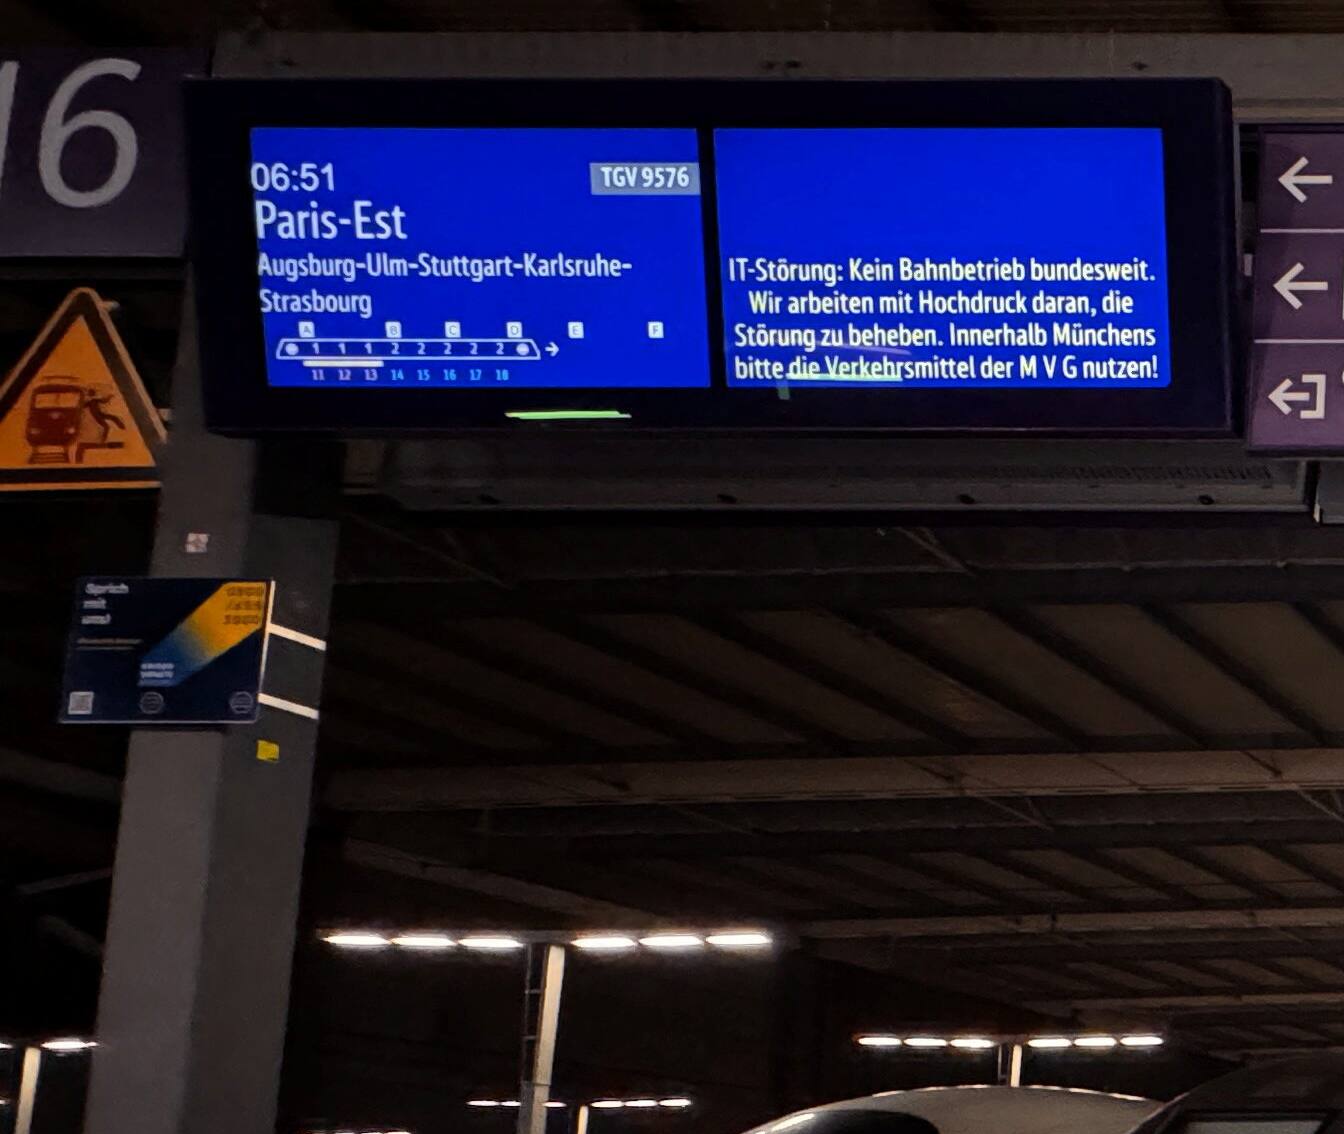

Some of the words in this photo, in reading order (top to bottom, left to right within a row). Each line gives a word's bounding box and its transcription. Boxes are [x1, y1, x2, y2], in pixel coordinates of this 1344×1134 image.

[251, 163, 335, 191] 06:51
[600, 166, 638, 188] TGV
[641, 166, 690, 188] 9576
[255, 200, 408, 240] Paris-Est
[258, 252, 632, 283] Augsburg-Ulm-Stuttgart-Karlsruhe-
[729, 257, 843, 287] IT-Störung:
[849, 257, 893, 281] Kein
[899, 257, 1025, 281] Bahnbetrieb
[1030, 257, 1155, 281] bundesweit.
[260, 288, 373, 319] Strasbourg
[748, 290, 782, 314] Wir
[787, 290, 874, 314] arbeiten
[879, 290, 914, 314] mit
[919, 289, 1027, 314] Hochdruck
[1032, 289, 1097, 317] daran,
[1102, 289, 1134, 314] die
[312, 342, 320, 355] 1
[338, 342, 346, 355] 1
[364, 342, 373, 355] 1
[391, 342, 400, 355] 2
[417, 342, 426, 355] 2
[444, 342, 452, 355] 2
[470, 342, 478, 355] 2
[496, 342, 505, 355] 2
[734, 323, 815, 352] Störung
[820, 329, 843, 347] zu
[849, 322, 944, 347] beheben.
[949, 322, 1047, 347] Innerhalb
[1053, 322, 1156, 347] Münchens
[312, 369, 325, 381] 11
[338, 369, 351, 381] 12
[364, 369, 378, 381] 13
[391, 369, 404, 381] 14
[417, 369, 430, 381] 15
[470, 369, 482, 381] 17
[735, 355, 785, 379] bitte
[789, 355, 821, 379] die
[825, 355, 976, 379] Verkehrsmittel
[980, 355, 1014, 379] der
[1019, 355, 1037, 379] M
[1043, 355, 1057, 379] V
[1062, 355, 1078, 379] G
[1083, 355, 1159, 379] nutzen!
